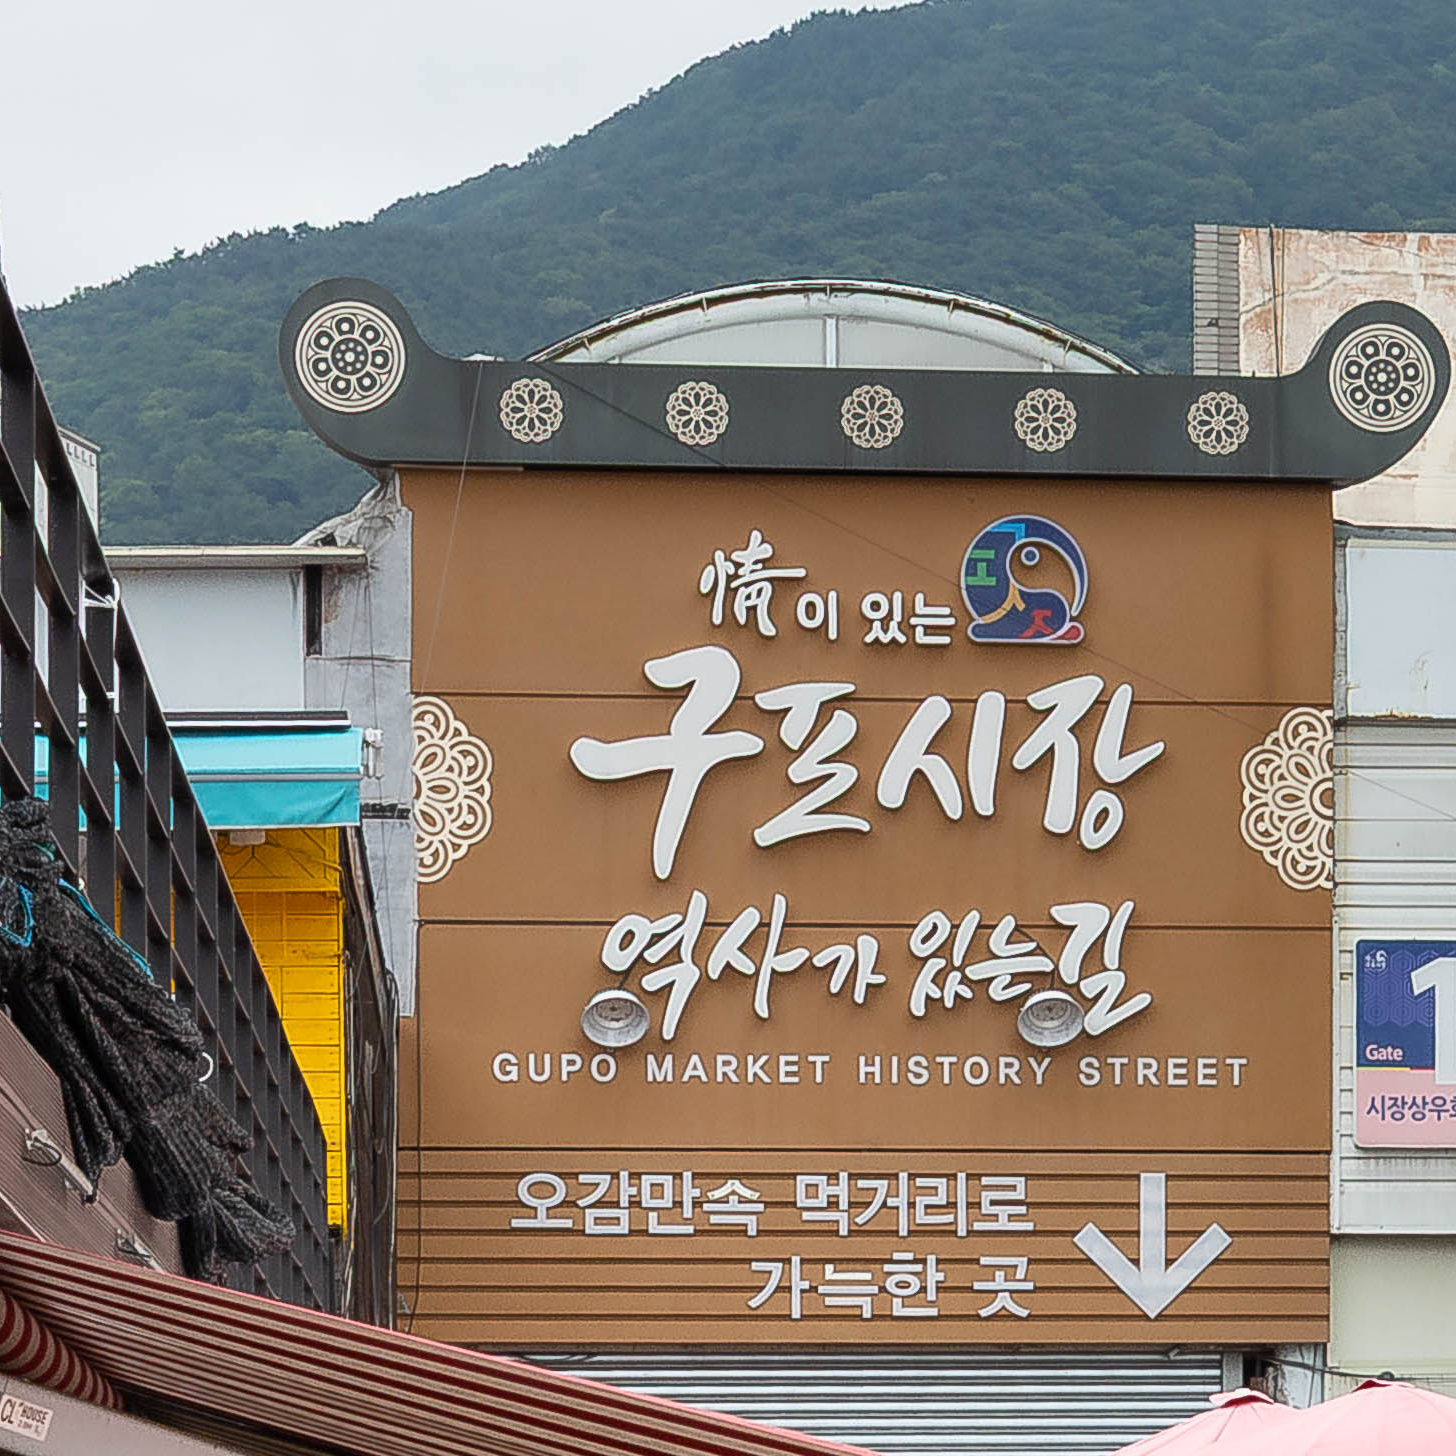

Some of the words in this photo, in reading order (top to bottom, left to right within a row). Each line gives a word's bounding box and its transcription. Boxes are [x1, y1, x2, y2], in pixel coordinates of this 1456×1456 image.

[861, 590, 957, 645] 있는
[569, 645, 1166, 880] 구포시장
[601, 890, 885, 1041] 역사가
[492, 1051, 619, 1084] GUPO
[645, 1053, 831, 1085] MARKET
[857, 1055, 1054, 1086] HISTORY
[1077, 1057, 1250, 1087] STREET
[1364, 1044, 1404, 1061] Gate
[795, 1171, 1036, 1237] 먹거리로
[972, 1255, 1036, 1319] 곳
